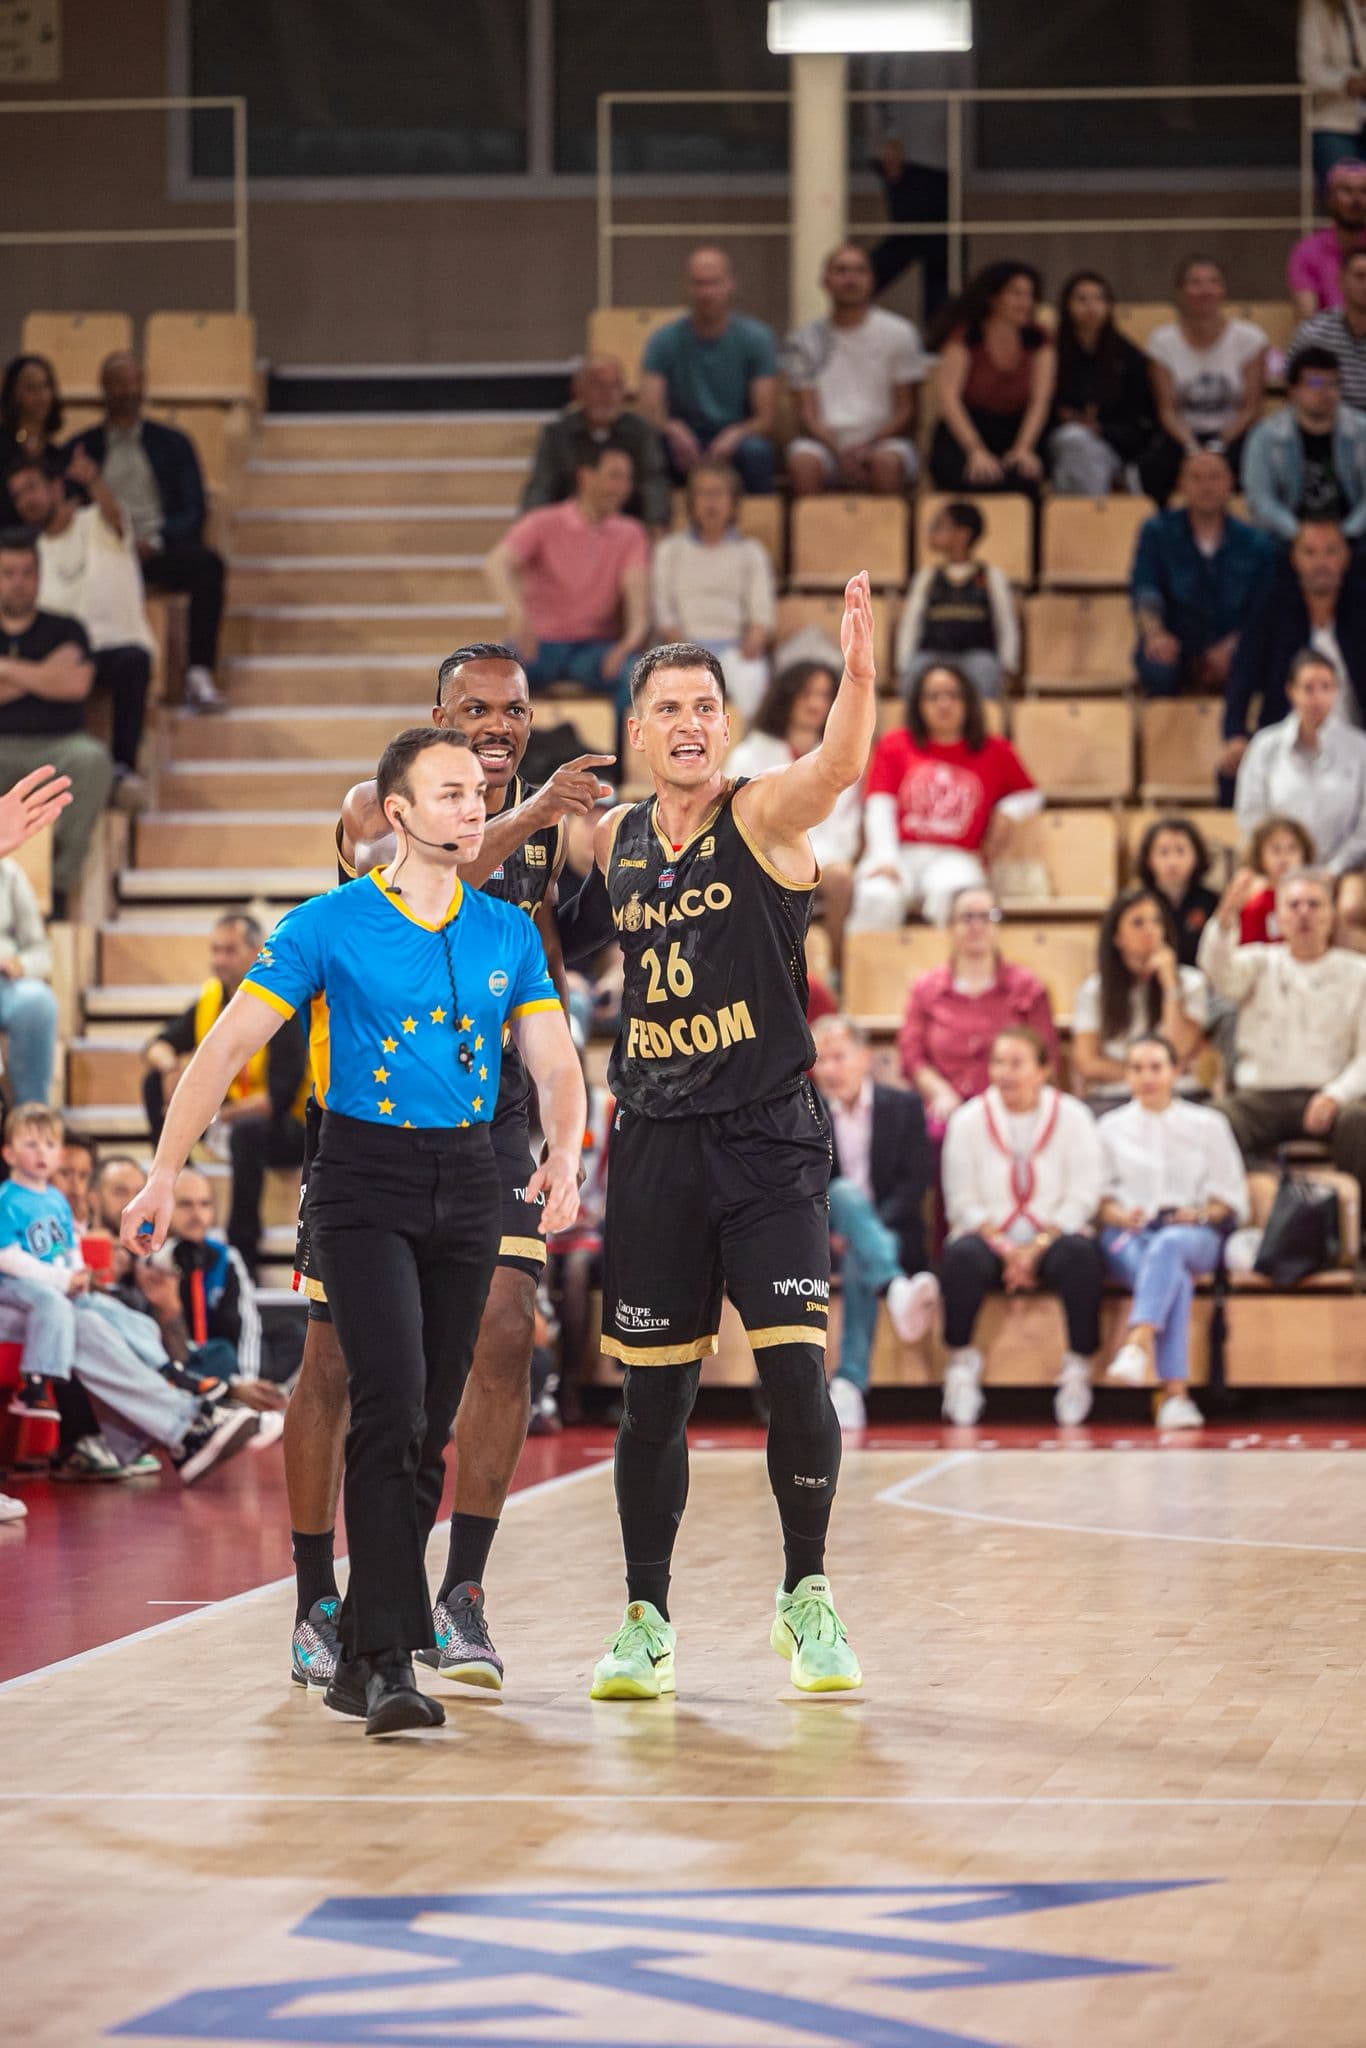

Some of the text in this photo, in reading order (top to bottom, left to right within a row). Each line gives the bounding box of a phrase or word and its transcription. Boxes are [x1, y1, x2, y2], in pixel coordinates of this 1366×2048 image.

[641, 941, 694, 1004] 26
[627, 1000, 757, 1059] FEDCOM
[632, 1316, 670, 1327] PASTOR
